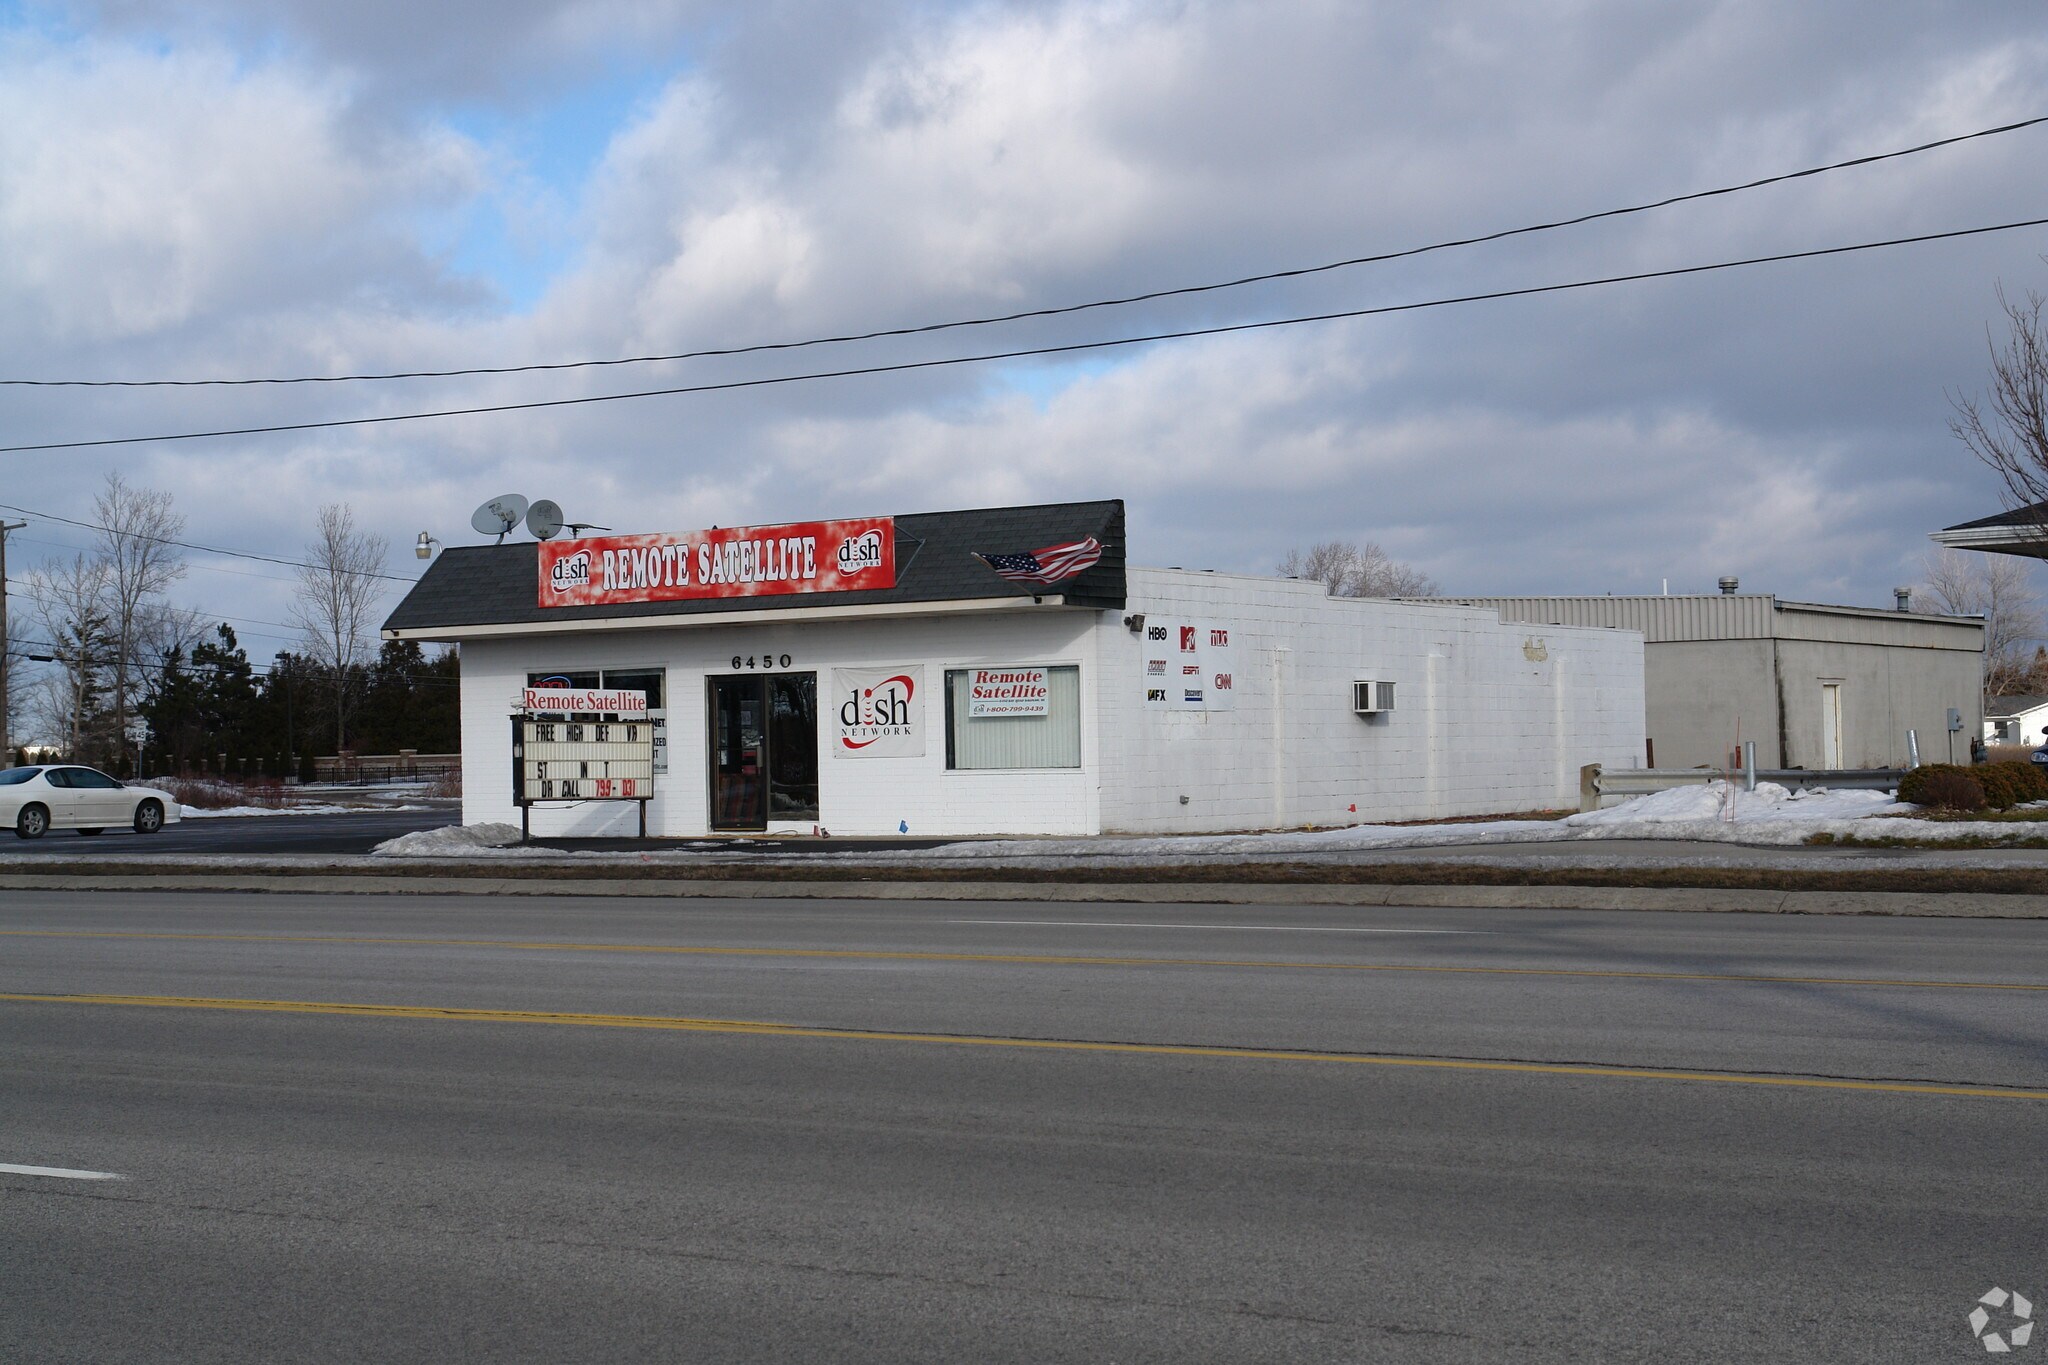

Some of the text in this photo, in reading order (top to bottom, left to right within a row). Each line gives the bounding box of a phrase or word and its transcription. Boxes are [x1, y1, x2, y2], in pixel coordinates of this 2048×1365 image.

[839, 537, 880, 562] dish
[552, 557, 588, 580] dish
[603, 536, 817, 591] REMOTE SATELLITE
[839, 560, 880, 568] NETWORK
[1148, 626, 1167, 641] HBO
[1210, 630, 1228, 647] TLC
[731, 654, 792, 669] 6450
[975, 670, 1042, 684] Remote
[1183, 666, 1199, 675] ESPN
[1214, 673, 1232, 689] CNN
[972, 684, 1047, 699] Satellite
[1184, 688, 1203, 698] Discovery
[526, 690, 646, 711] Remote Satellite
[840, 687, 911, 726] dish
[536, 724, 555, 742] FREE
[566, 724, 583, 742] HIGH
[595, 724, 610, 742] DEF
[841, 726, 911, 737] NETWORK
[537, 761, 609, 779] ST IN T
[561, 780, 580, 797] CALL
